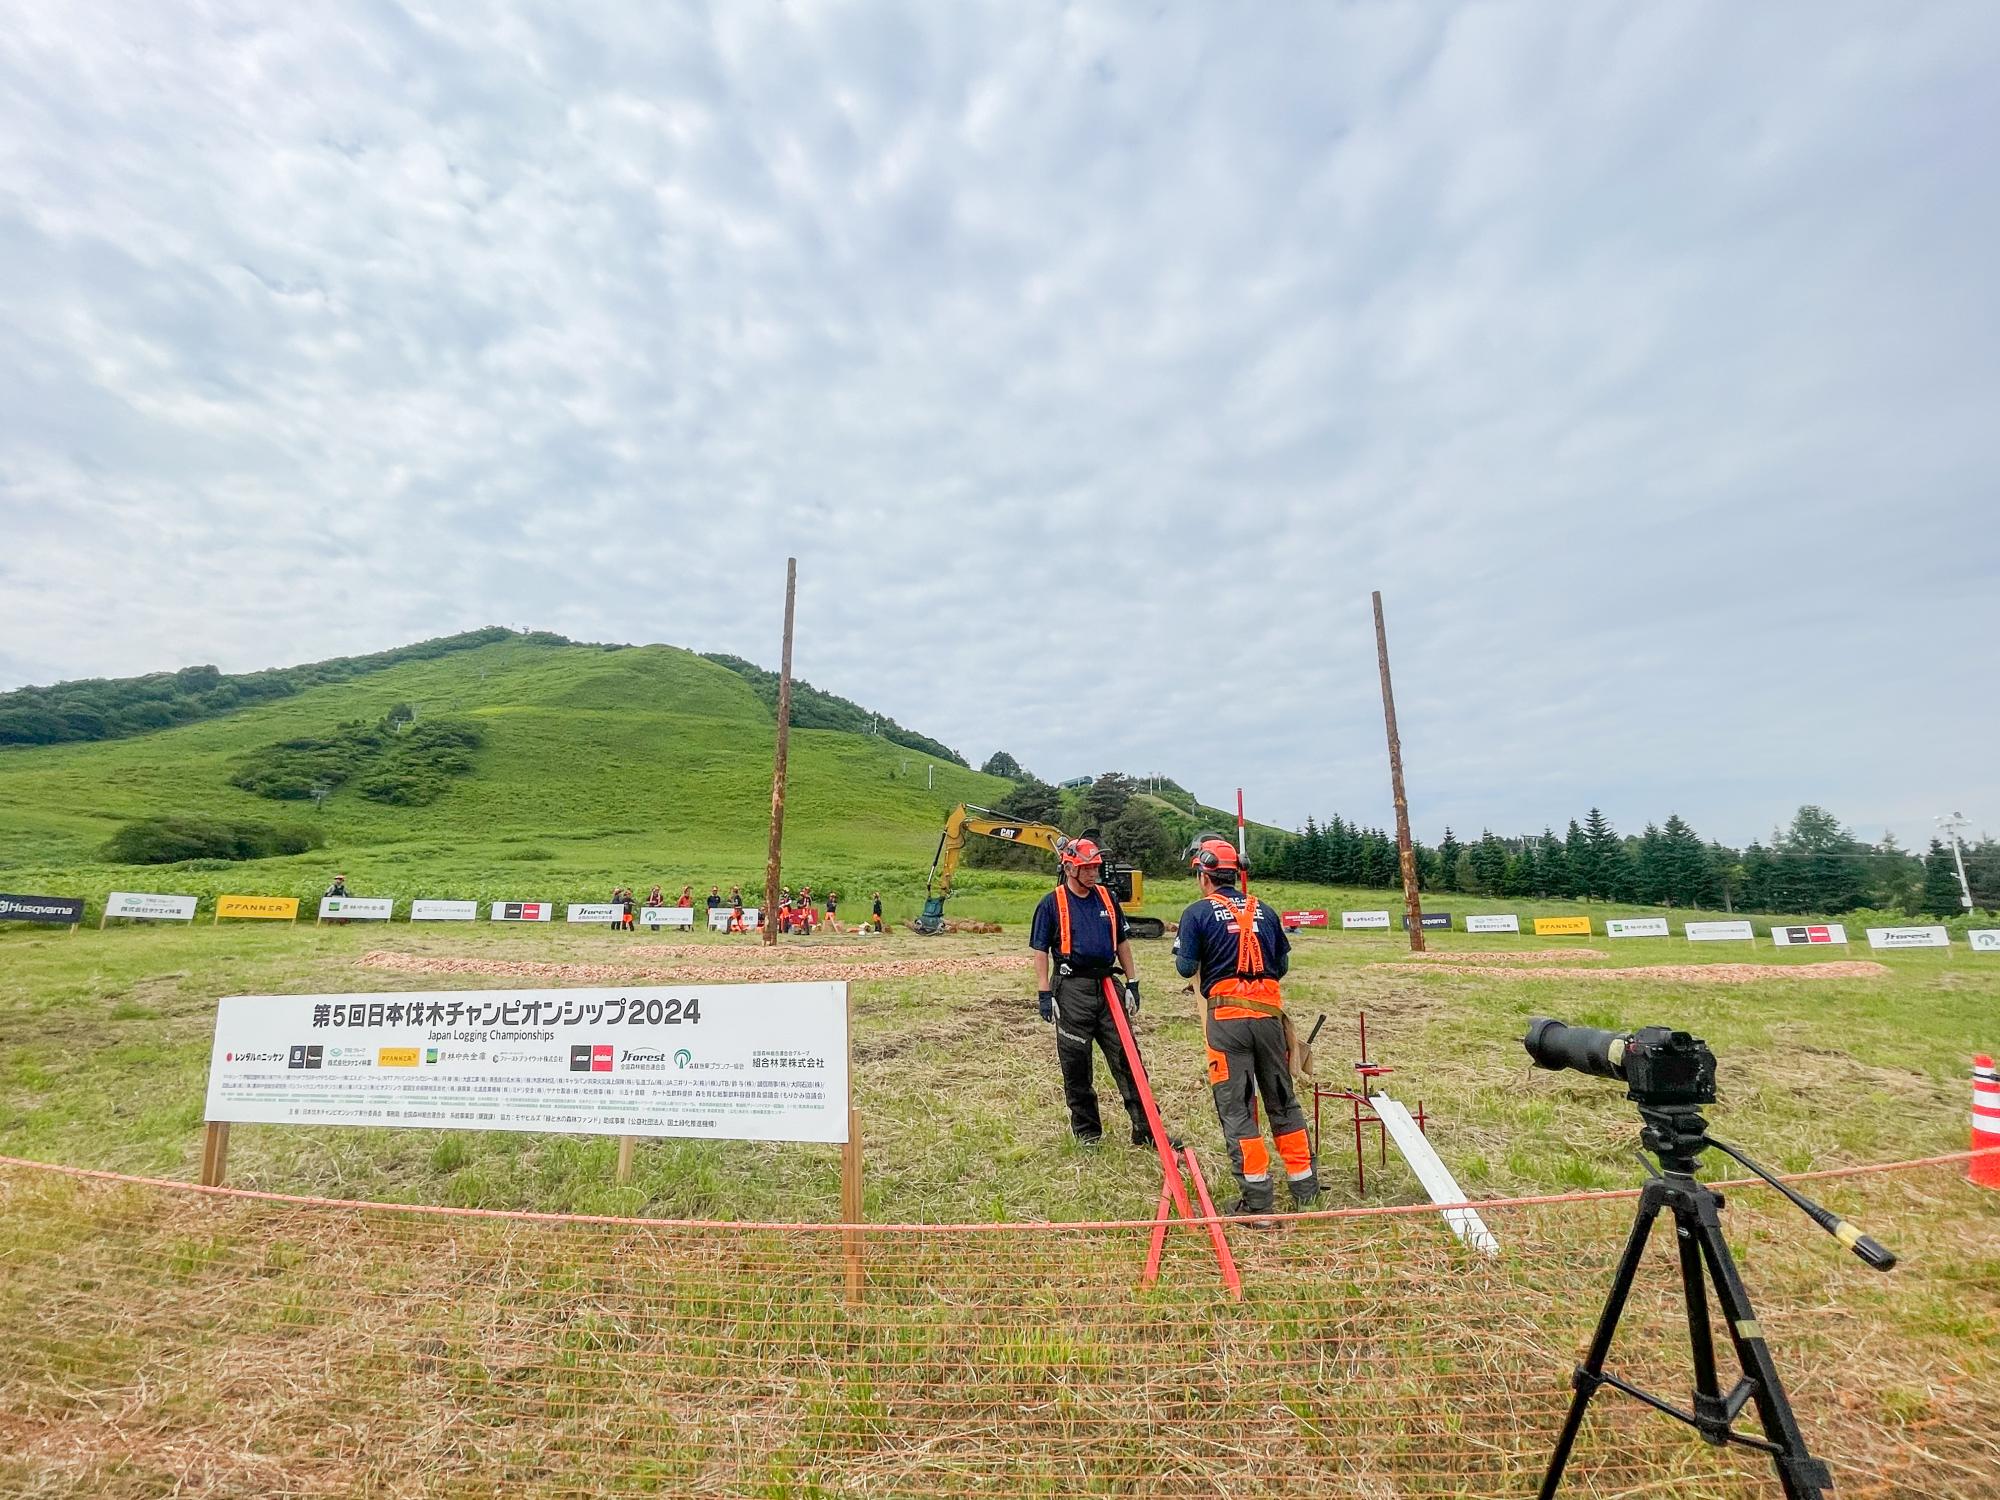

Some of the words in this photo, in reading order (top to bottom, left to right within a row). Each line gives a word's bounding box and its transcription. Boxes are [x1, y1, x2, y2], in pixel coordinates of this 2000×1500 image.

[1000, 827, 1015, 838] CAT
[9, 902, 73, 915] Husqvarna
[226, 903, 286, 912] PFANNER
[313, 997, 702, 1028] 第5回日本伐木チャンピオンシップ2024
[428, 1030, 452, 1043] Japan
[454, 1030, 488, 1043] Logging
[489, 1029, 555, 1042] Championships
[235, 1052, 285, 1062] レンタルのニッケン
[439, 1051, 487, 1061] 農林中央金庫
[621, 1050, 666, 1062] Jforest
[752, 1057, 825, 1069] 組合林業株式会社
